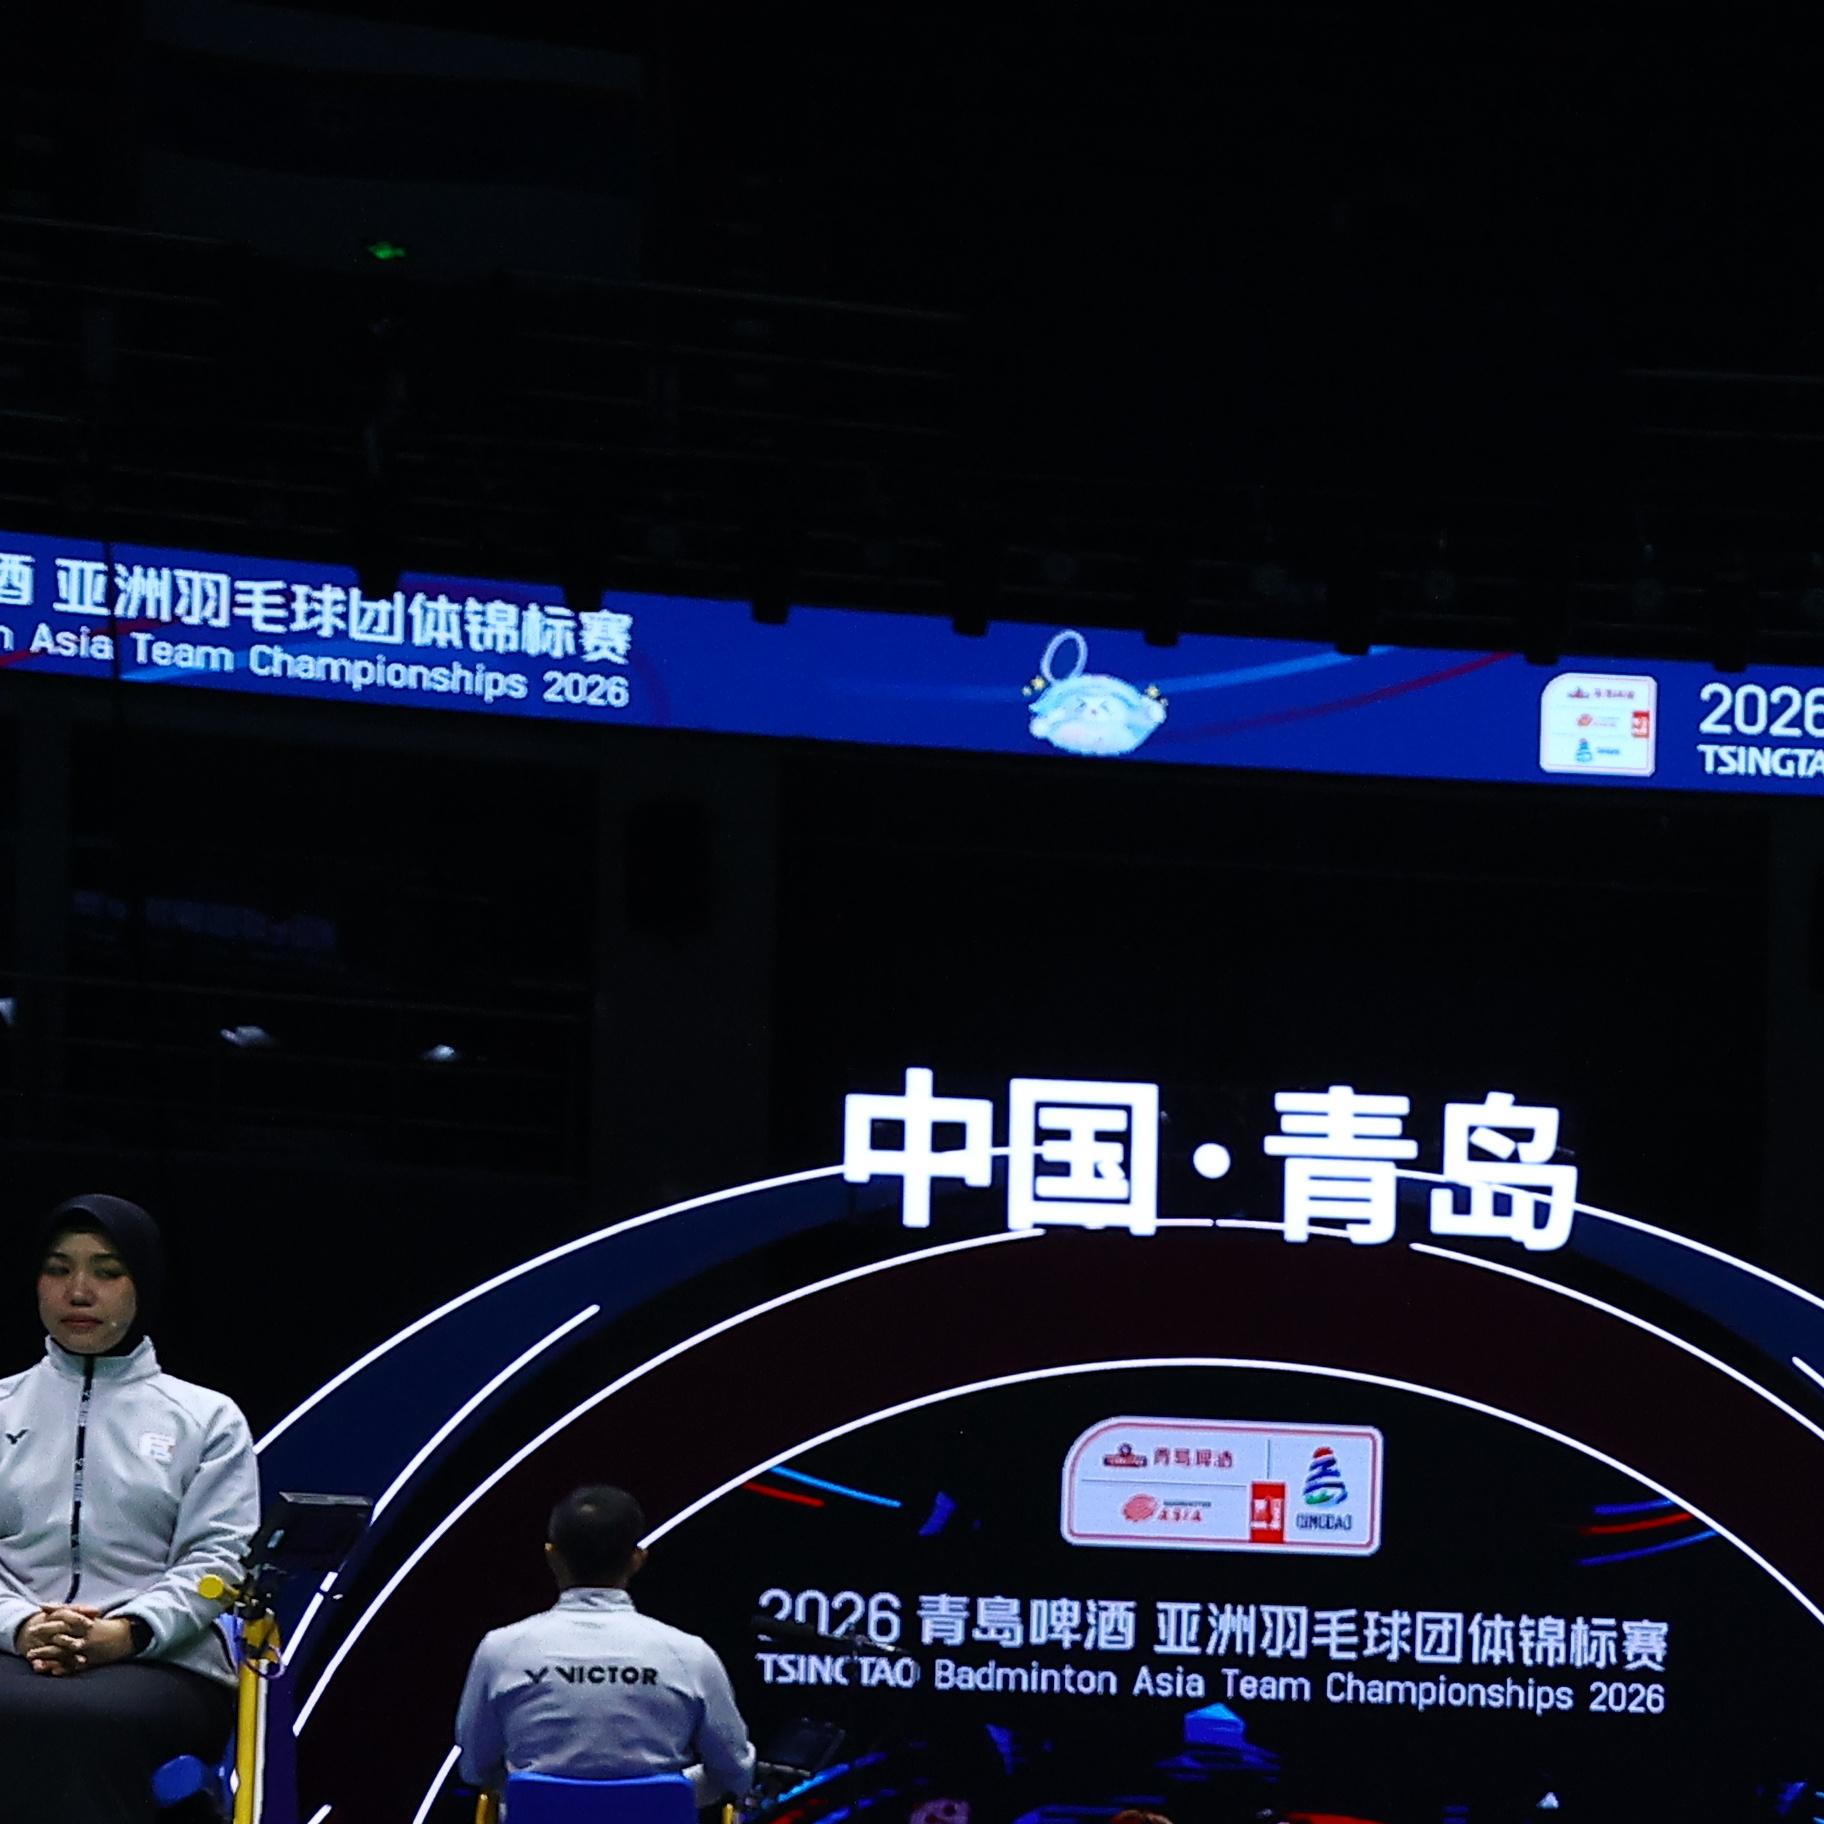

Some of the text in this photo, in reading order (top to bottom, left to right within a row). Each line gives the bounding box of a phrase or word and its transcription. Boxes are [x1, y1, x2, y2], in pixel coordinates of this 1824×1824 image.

[53, 557, 632, 665] 亚洲羽毛球团体锦标赛
[29, 622, 114, 660] Asia
[129, 631, 234, 673] Team
[249, 643, 528, 704] Championships
[542, 670, 630, 708] 2026
[843, 1067, 1579, 1251] 中国·青岛
[916, 1594, 1138, 1653] 青島啤酒
[1153, 1601, 1670, 1672] 亚洲羽毛球团体锦标赛
[554, 1666, 659, 1686] VICTOR
[934, 1658, 1118, 1696] Badminton
[1132, 1665, 1206, 1699] Asia
[1221, 1668, 1311, 1703] Team
[1326, 1671, 1574, 1717] Championships
[1588, 1681, 1667, 1715] 2026
